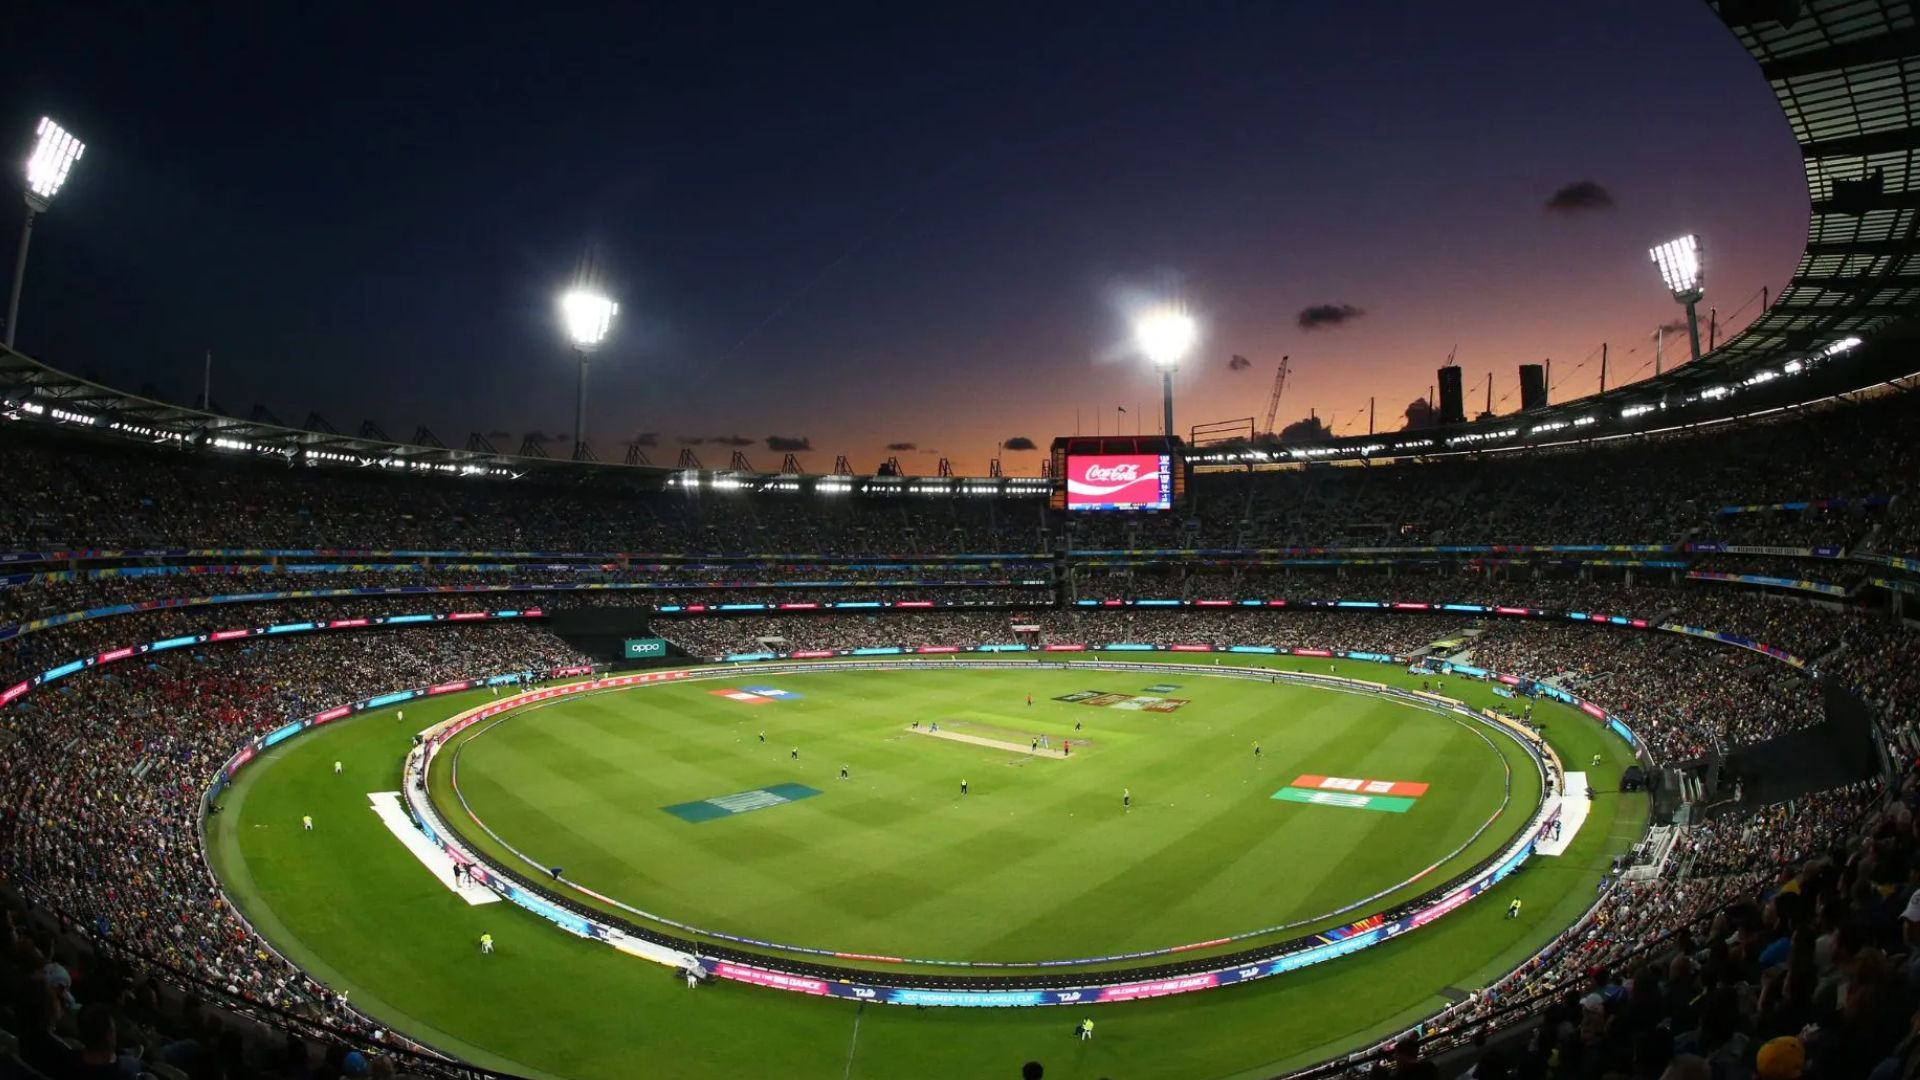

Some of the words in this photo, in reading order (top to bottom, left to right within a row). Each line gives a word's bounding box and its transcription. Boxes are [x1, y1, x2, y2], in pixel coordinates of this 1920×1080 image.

[632, 643, 659, 652] oppo
[1239, 968, 1259, 978] T20
[789, 978, 820, 989] DANCE
[1162, 981, 1179, 991] BIG
[1179, 977, 1209, 987] DANCE
[852, 988, 876, 998] T20
[1057, 992, 1082, 1001] T20
